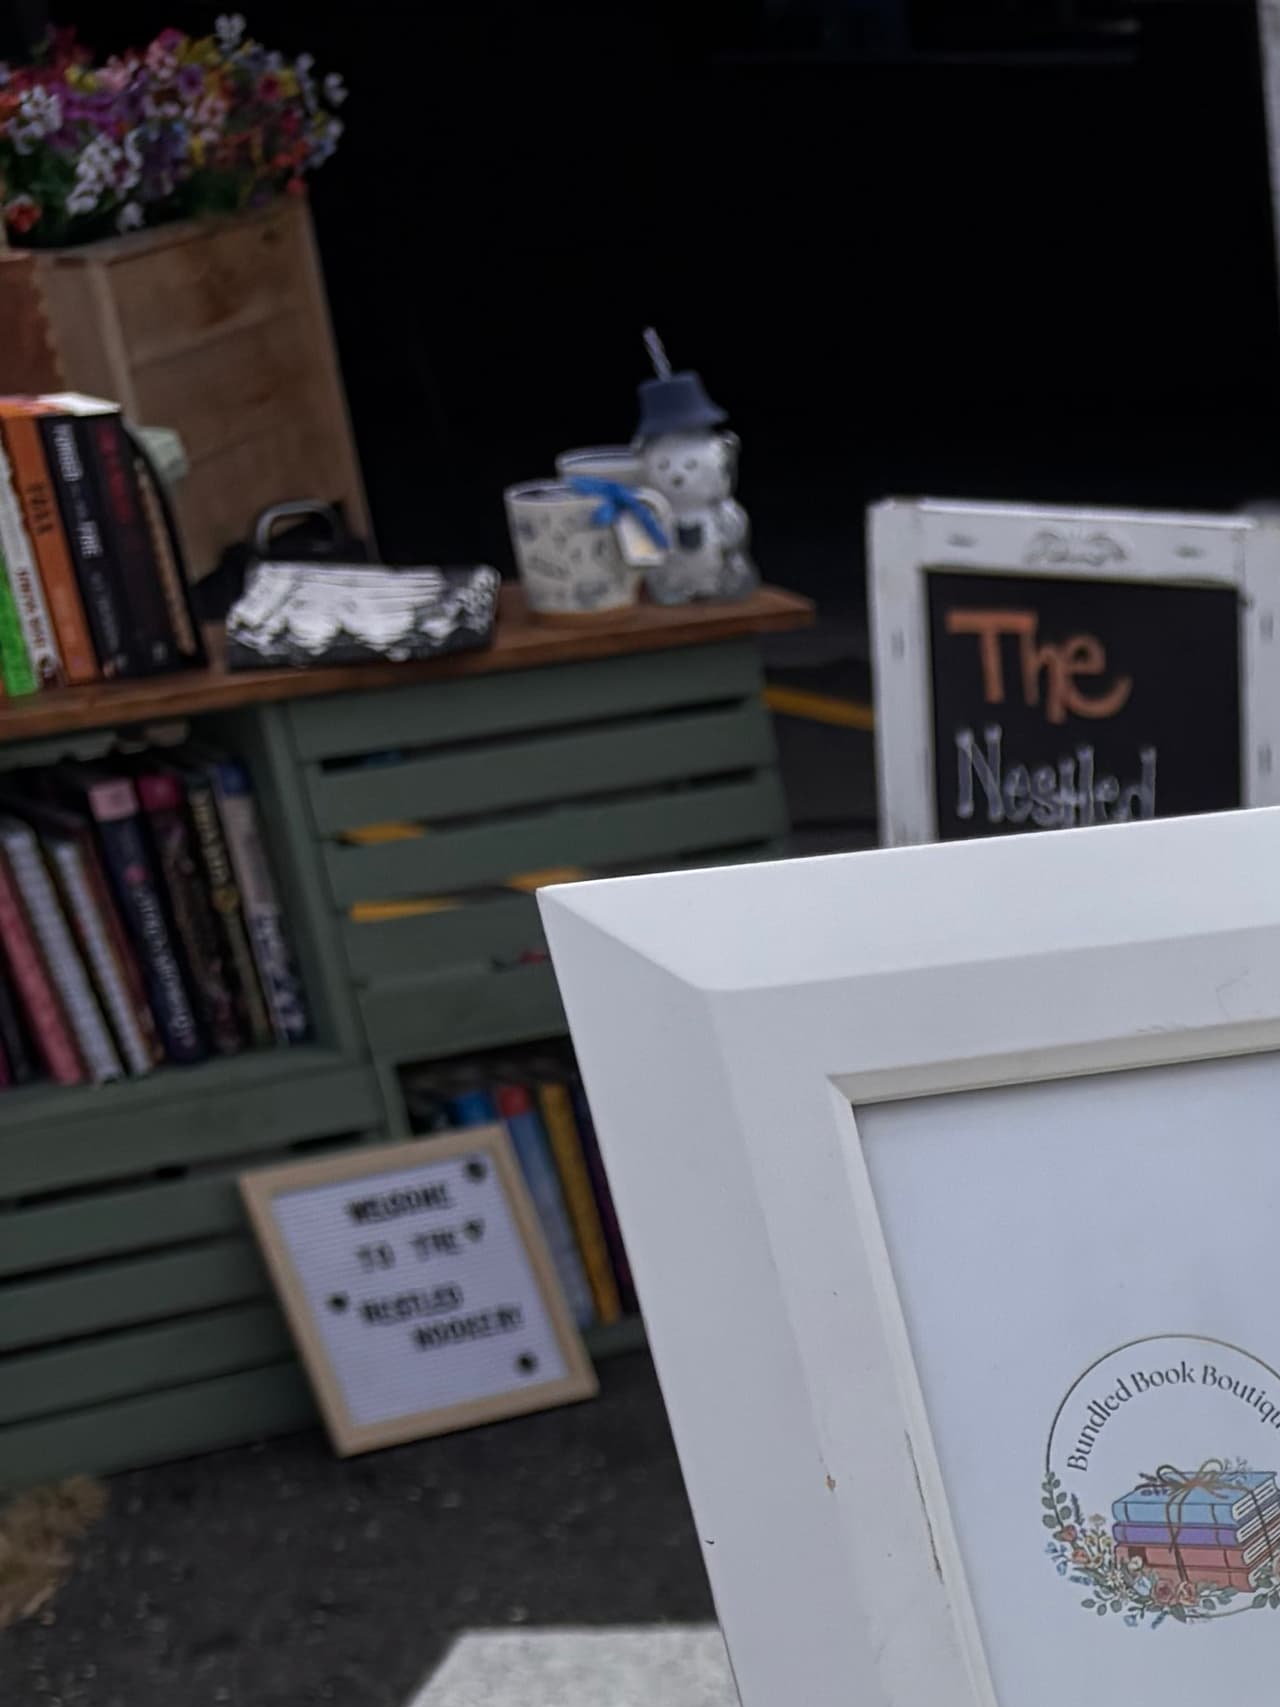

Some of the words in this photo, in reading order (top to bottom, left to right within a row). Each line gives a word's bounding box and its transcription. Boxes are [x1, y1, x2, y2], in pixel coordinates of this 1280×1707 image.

[946, 610, 1131, 724] The
[1067, 1378, 1133, 1472] Bundled
[1131, 1360, 1197, 1394] Book
